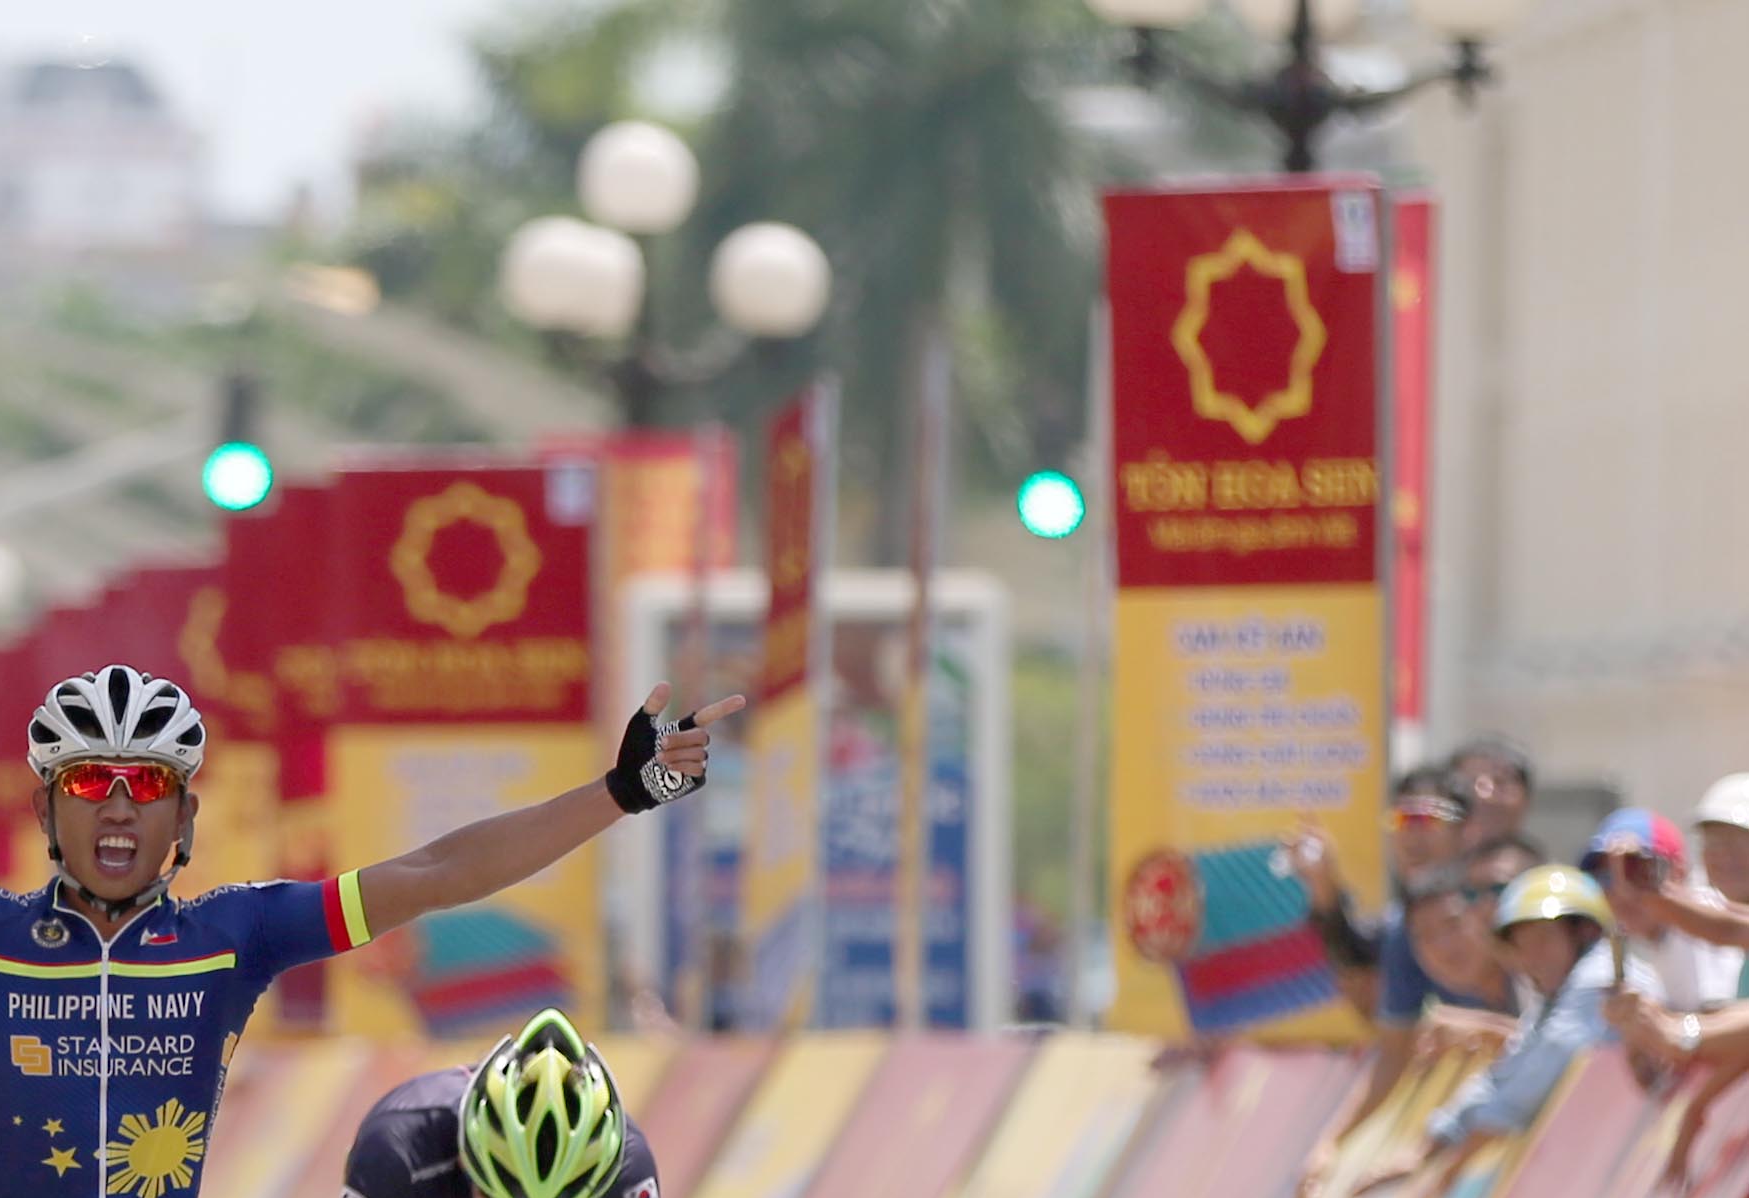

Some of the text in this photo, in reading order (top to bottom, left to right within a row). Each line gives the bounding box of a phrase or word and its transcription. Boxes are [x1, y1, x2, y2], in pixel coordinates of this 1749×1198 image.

[8, 991, 205, 1020] PHILIPPINE NAVY
[57, 1035, 195, 1055] STANDARD
[57, 1056, 193, 1077] INSURANCE
